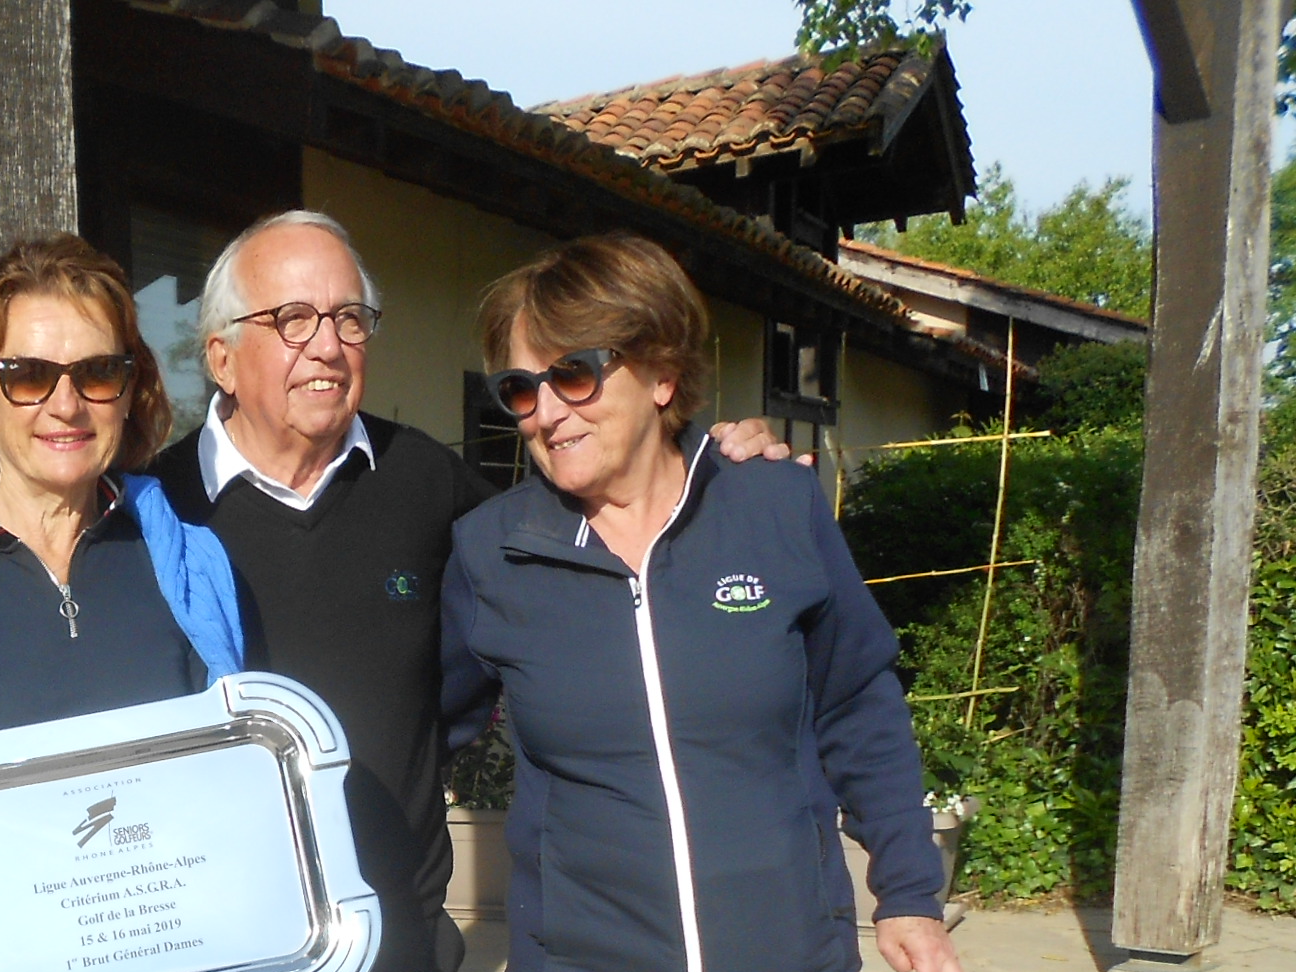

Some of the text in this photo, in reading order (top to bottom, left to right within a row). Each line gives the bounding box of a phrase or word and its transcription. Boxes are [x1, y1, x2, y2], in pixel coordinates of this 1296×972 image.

[717, 574, 759, 586] LIGUE DE
[716, 585, 764, 601] GOLF
[63, 777, 142, 796] ASSOCIATION
[113, 822, 149, 835] SENIORS
[114, 832, 151, 845] GOLFEURS
[75, 842, 153, 862] RHONE ALPES
[34, 853, 206, 894] Ligue Auvergne-Rhône-Alpes
[60, 878, 186, 910] Critérium A.S.G.R.A.
[78, 900, 176, 926] Golf de la Bresse
[80, 918, 182, 947] 15 & 16 mai 2019
[83, 952, 110, 968] Brut
[113, 944, 161, 962] Général
[164, 937, 204, 953] Dames
